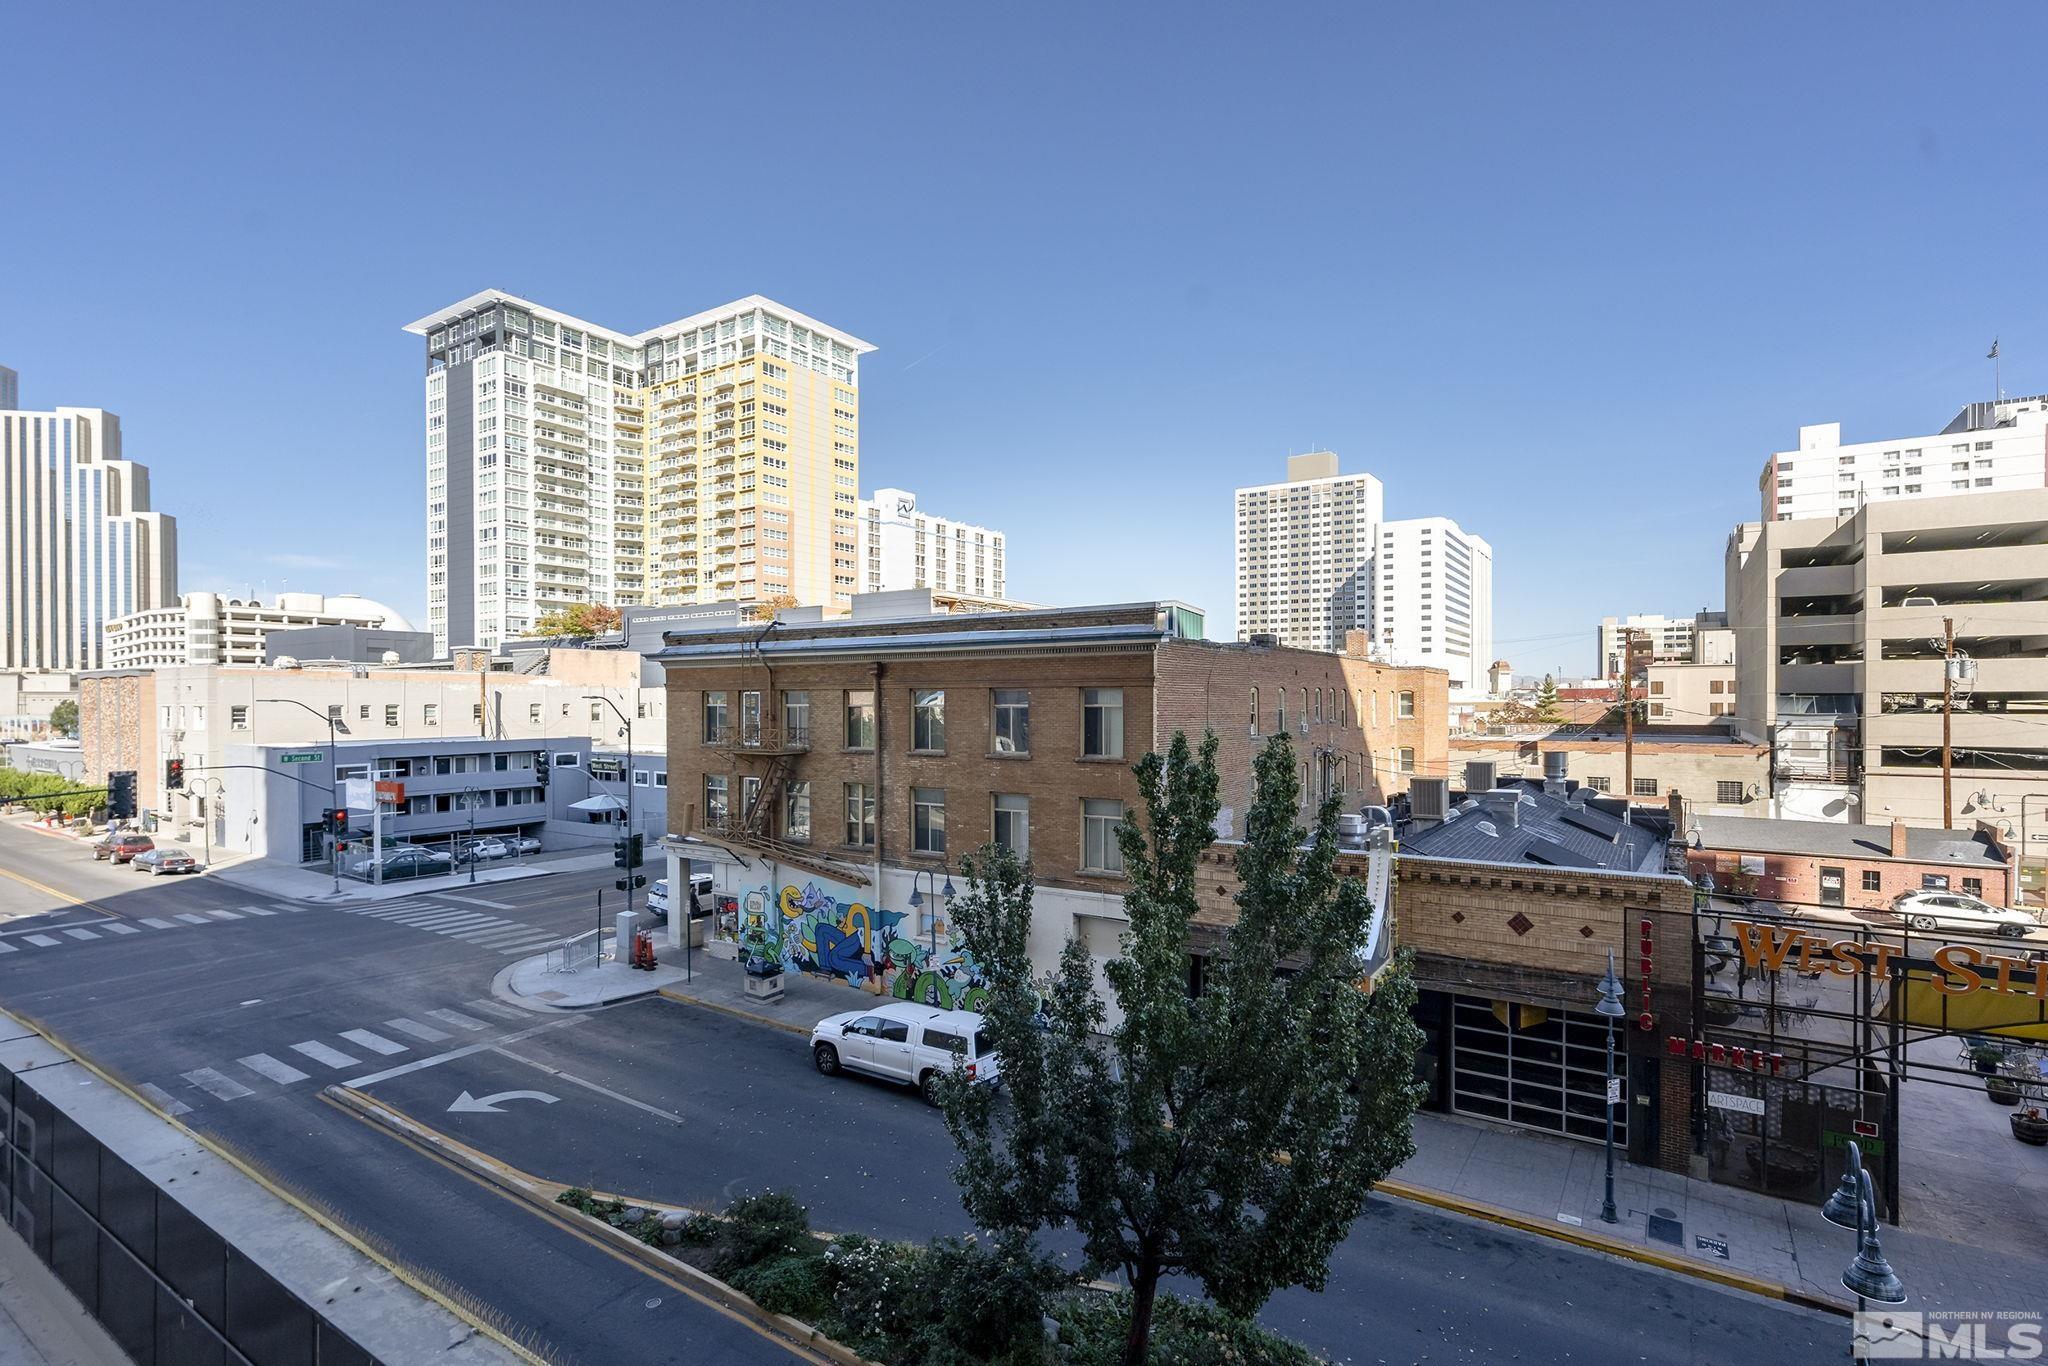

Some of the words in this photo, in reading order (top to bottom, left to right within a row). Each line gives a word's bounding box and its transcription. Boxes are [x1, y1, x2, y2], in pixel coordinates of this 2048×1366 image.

[1640, 919, 1653, 1031] PUBLIC
[1668, 1036, 1782, 1072] MARKET
[1710, 1094, 1764, 1113] ARTSPACE
